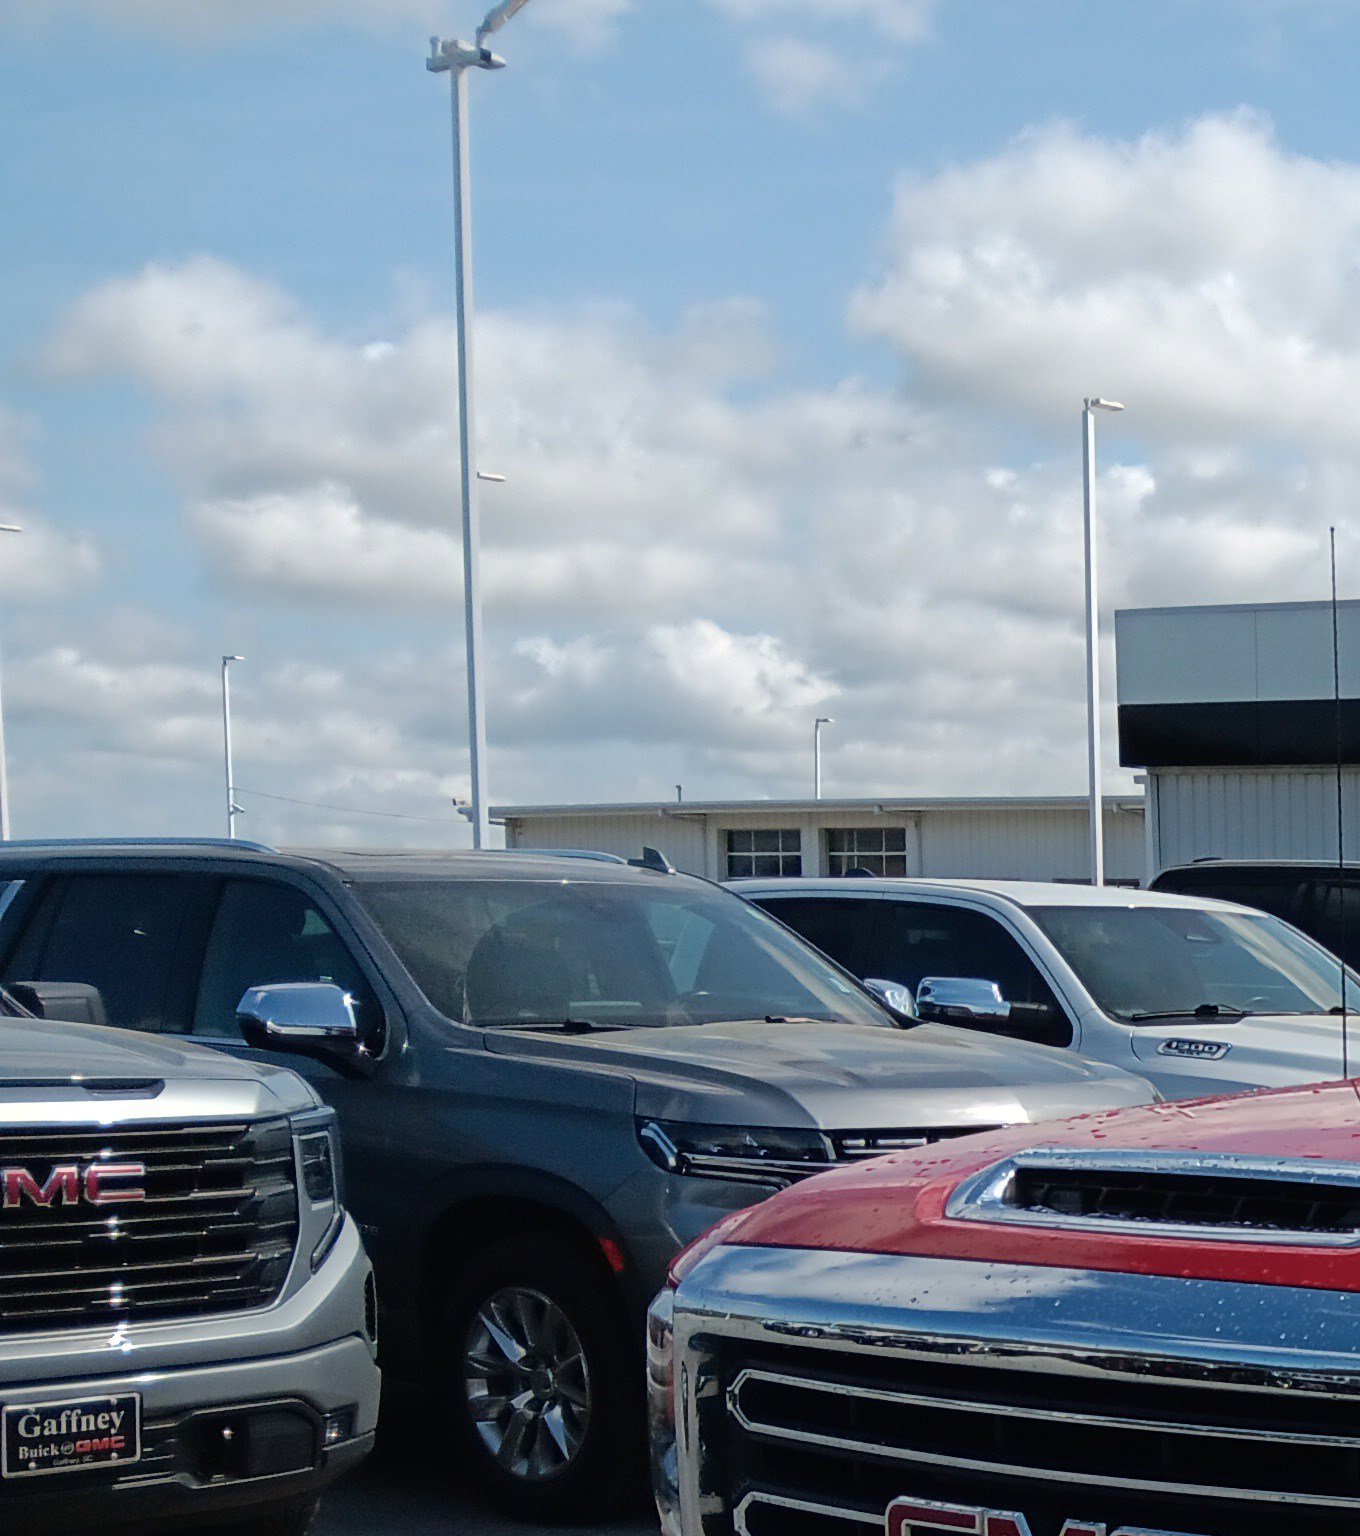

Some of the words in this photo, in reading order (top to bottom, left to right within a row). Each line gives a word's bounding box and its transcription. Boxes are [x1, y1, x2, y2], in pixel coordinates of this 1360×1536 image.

[0, 1162, 147, 1208] MC
[17, 1408, 125, 1438] Gaffney
[19, 1443, 60, 1460] Buick
[75, 1435, 125, 1453] GMC
